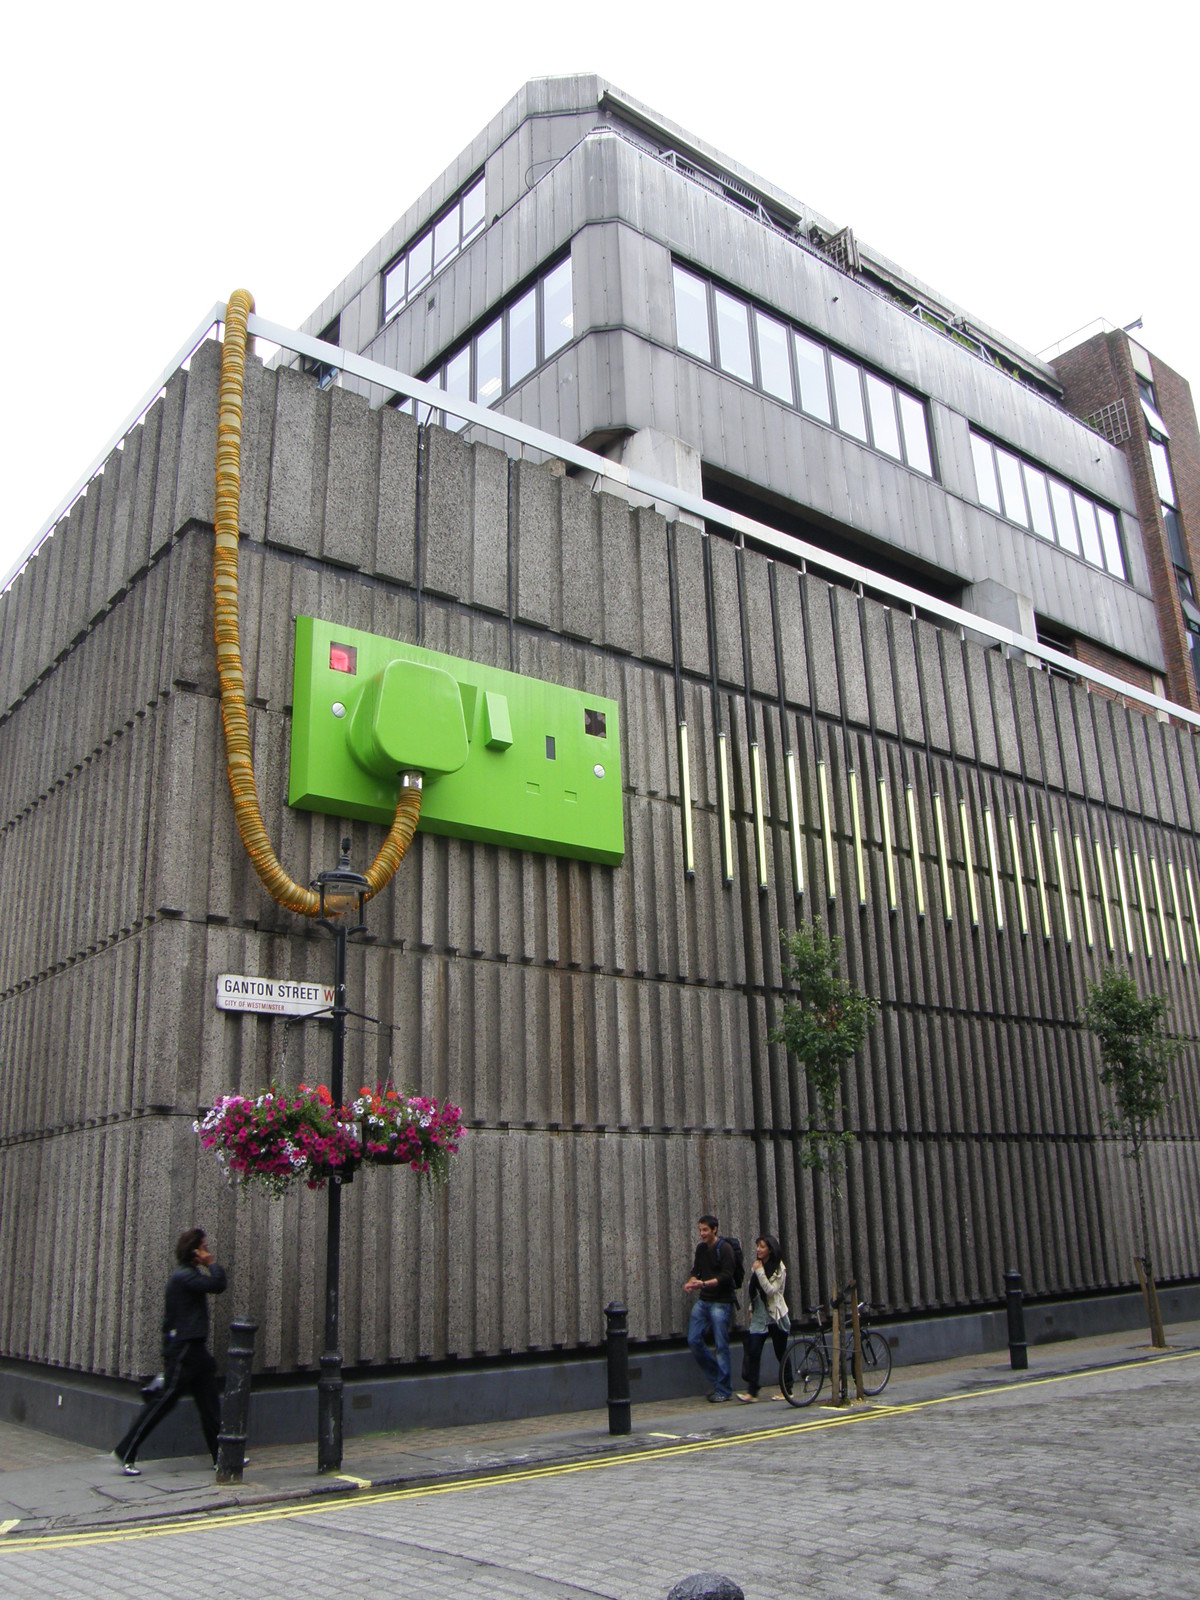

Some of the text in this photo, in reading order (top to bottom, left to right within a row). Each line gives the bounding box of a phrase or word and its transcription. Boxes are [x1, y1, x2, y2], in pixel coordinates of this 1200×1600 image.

[224, 980, 274, 996] GANTON
[278, 984, 320, 1000] STREET
[246, 1001, 284, 1010] WESTMINSTER
